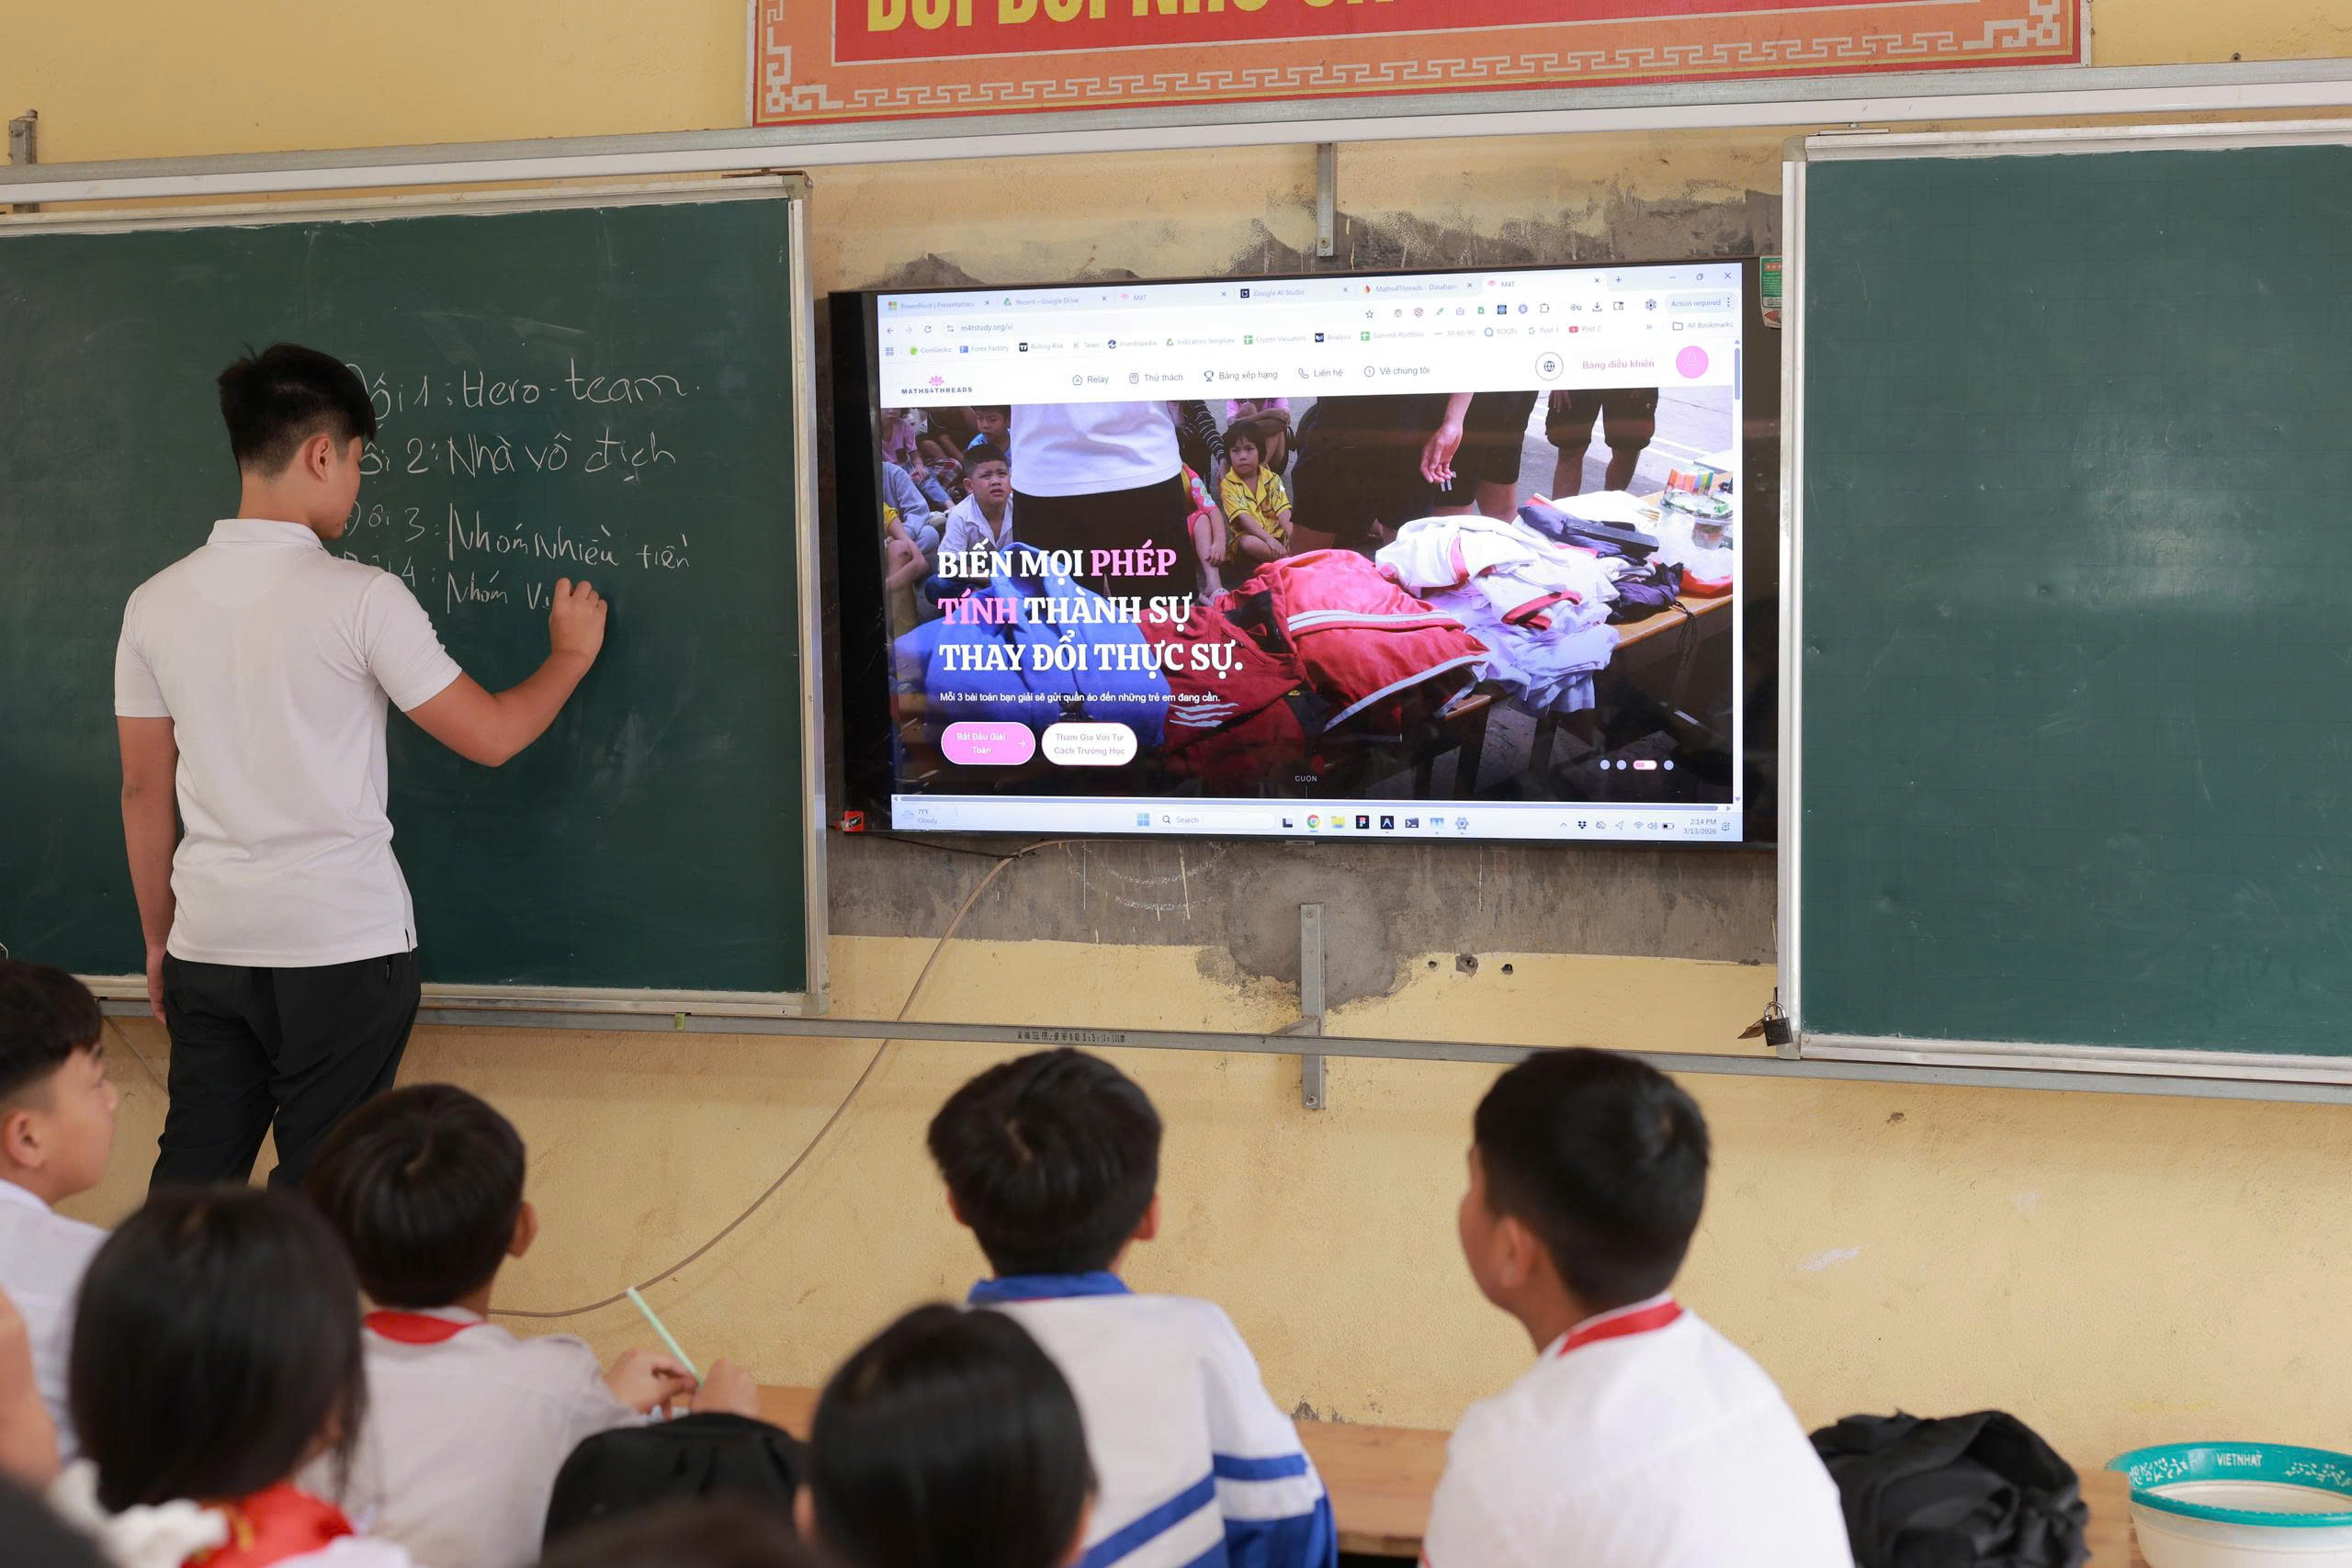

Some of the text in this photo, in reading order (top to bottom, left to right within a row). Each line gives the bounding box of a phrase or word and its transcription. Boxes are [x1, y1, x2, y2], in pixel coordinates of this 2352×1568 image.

[1041, 298, 1062, 306] Google
[1693, 299, 1721, 308] required
[1087, 376, 1109, 384] Relay
[901, 386, 973, 394] MATHS4THREADS
[447, 434, 514, 478] Nhà
[525, 432, 572, 472] vô
[937, 540, 1177, 585] BIẾN MỌI PHÉP
[937, 586, 1193, 632] TÍNH THÀNH SỰ
[939, 629, 1243, 679] THAY ĐỔI THỰC SỰ.
[940, 691, 956, 702] Mỗi
[957, 693, 963, 701] 3
[965, 693, 978, 702] bài
[979, 693, 998, 702] toán
[1000, 693, 1016, 704] bạn
[1018, 692, 1034, 704] giải
[1035, 693, 1046, 702] sẽ
[1047, 692, 1062, 704] gửi
[1063, 691, 1085, 704] quần
[1087, 692, 1098, 702] áo
[1100, 691, 1116, 702] đến
[1118, 693, 1147, 704] những
[1178, 693, 1200, 704] đang
[1202, 691, 1221, 702] cần.
[1080, 733, 1093, 741] Gia
[1109, 747, 1125, 758] Học
